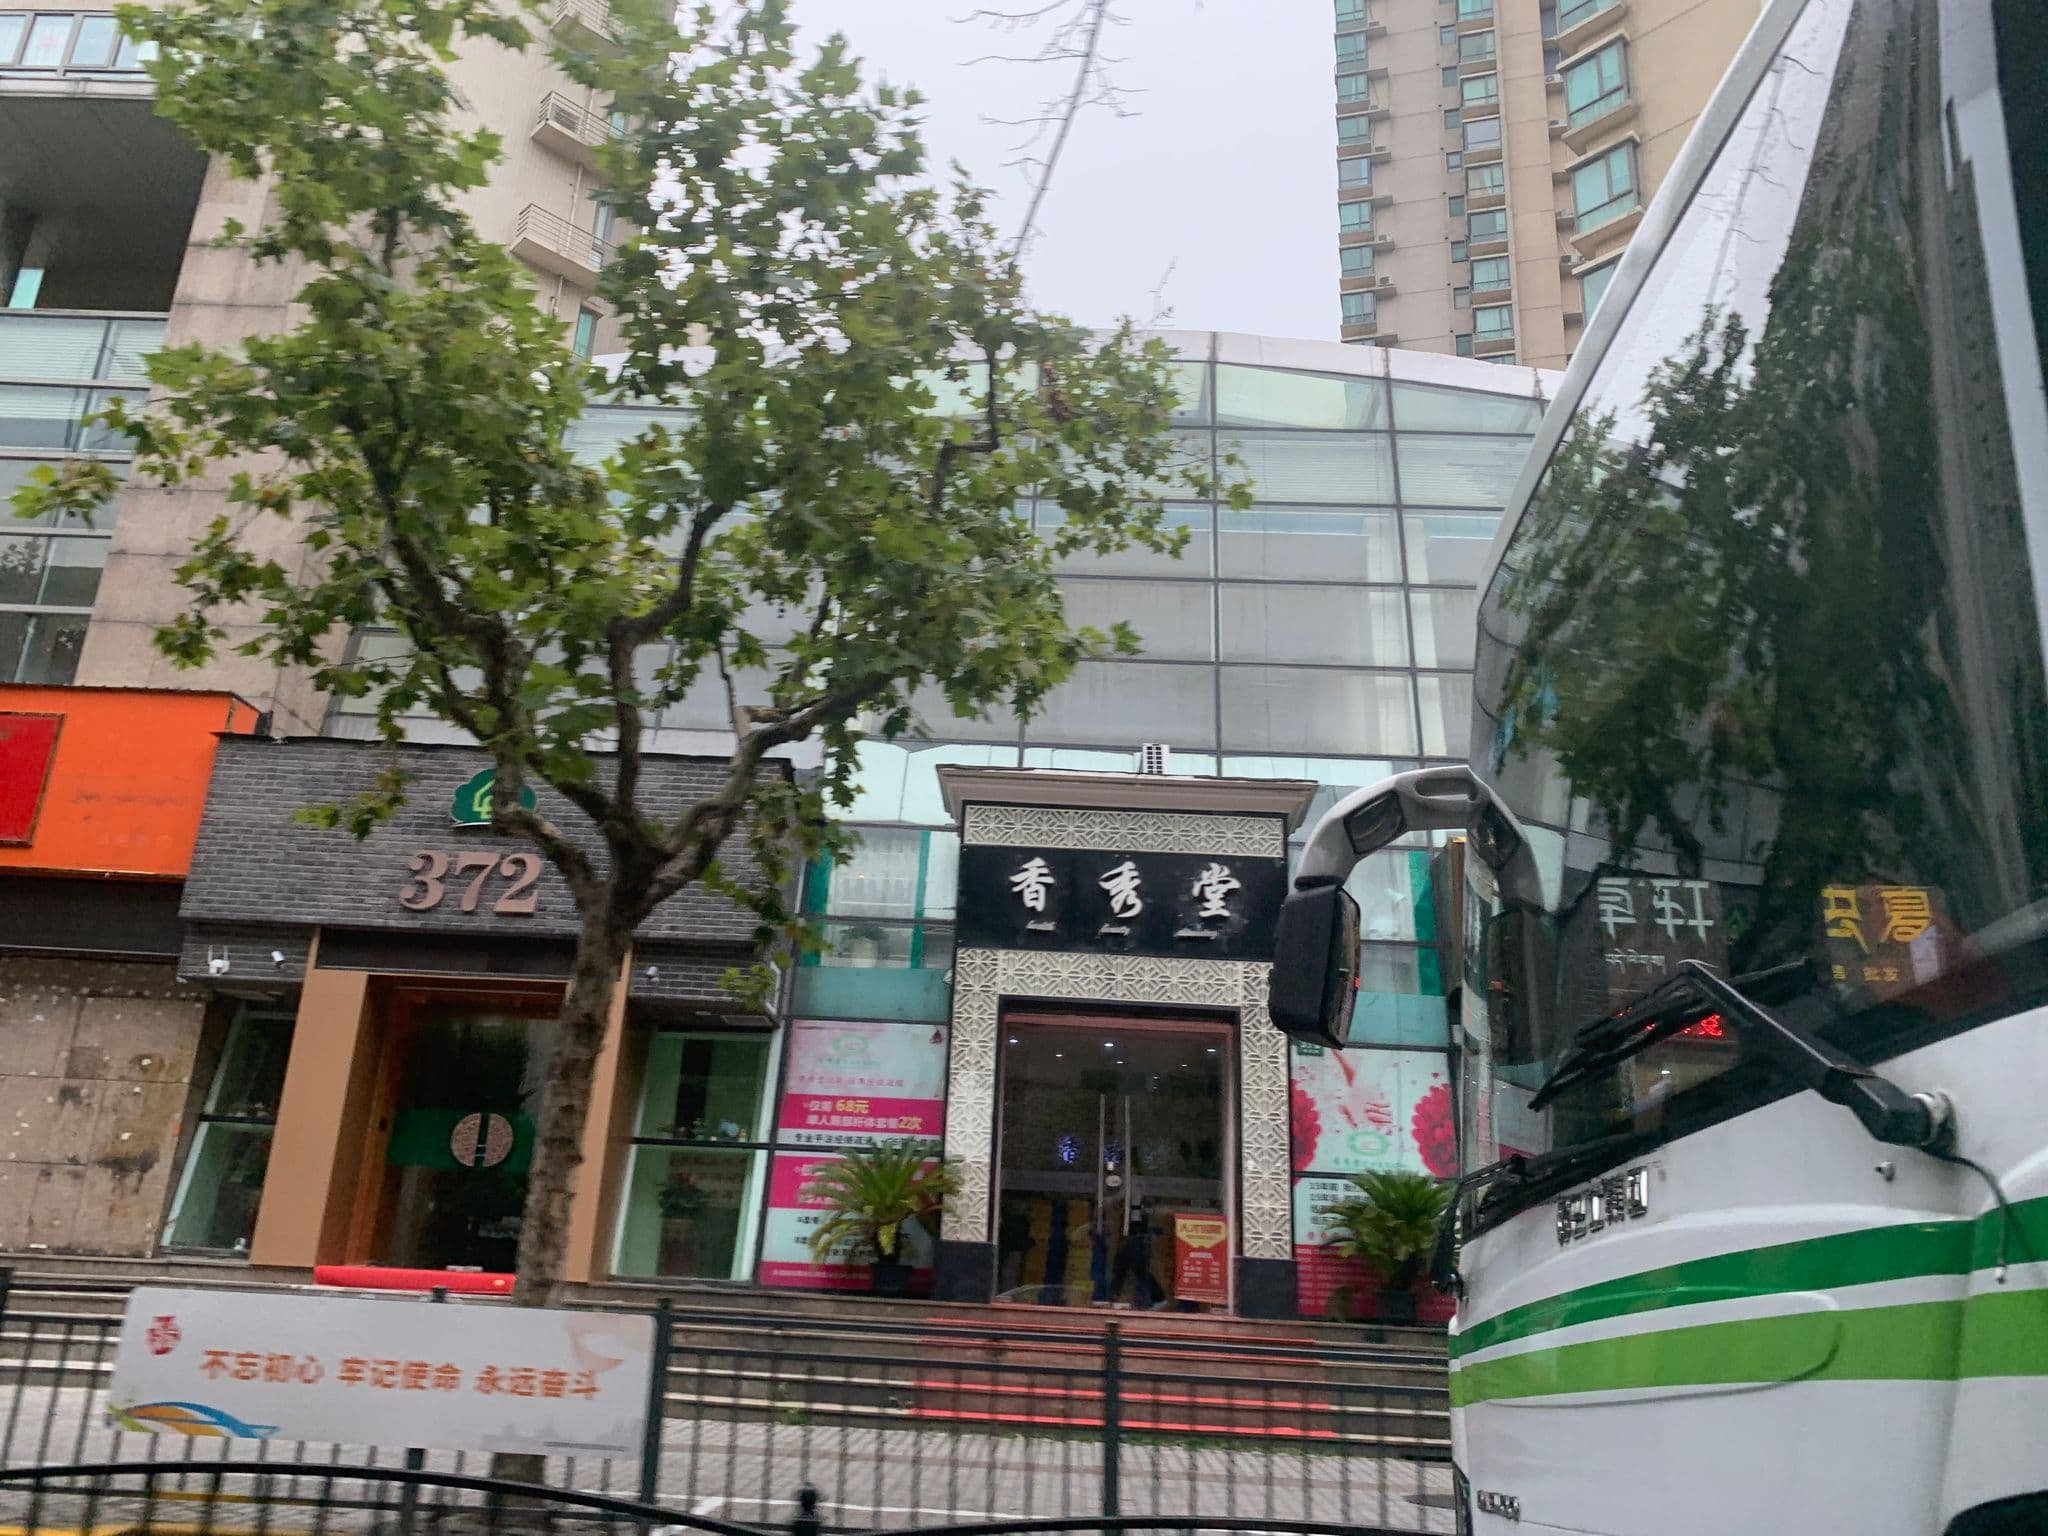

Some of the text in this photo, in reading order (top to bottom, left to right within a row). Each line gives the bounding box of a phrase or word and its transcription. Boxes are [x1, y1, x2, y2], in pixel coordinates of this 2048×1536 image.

[399, 850, 541, 916] 372
[1009, 857, 1241, 918] 香秀堂
[835, 1099, 870, 1113] 68元
[200, 1349, 600, 1400] 不忘初心 牢记使命 永远奋斗
